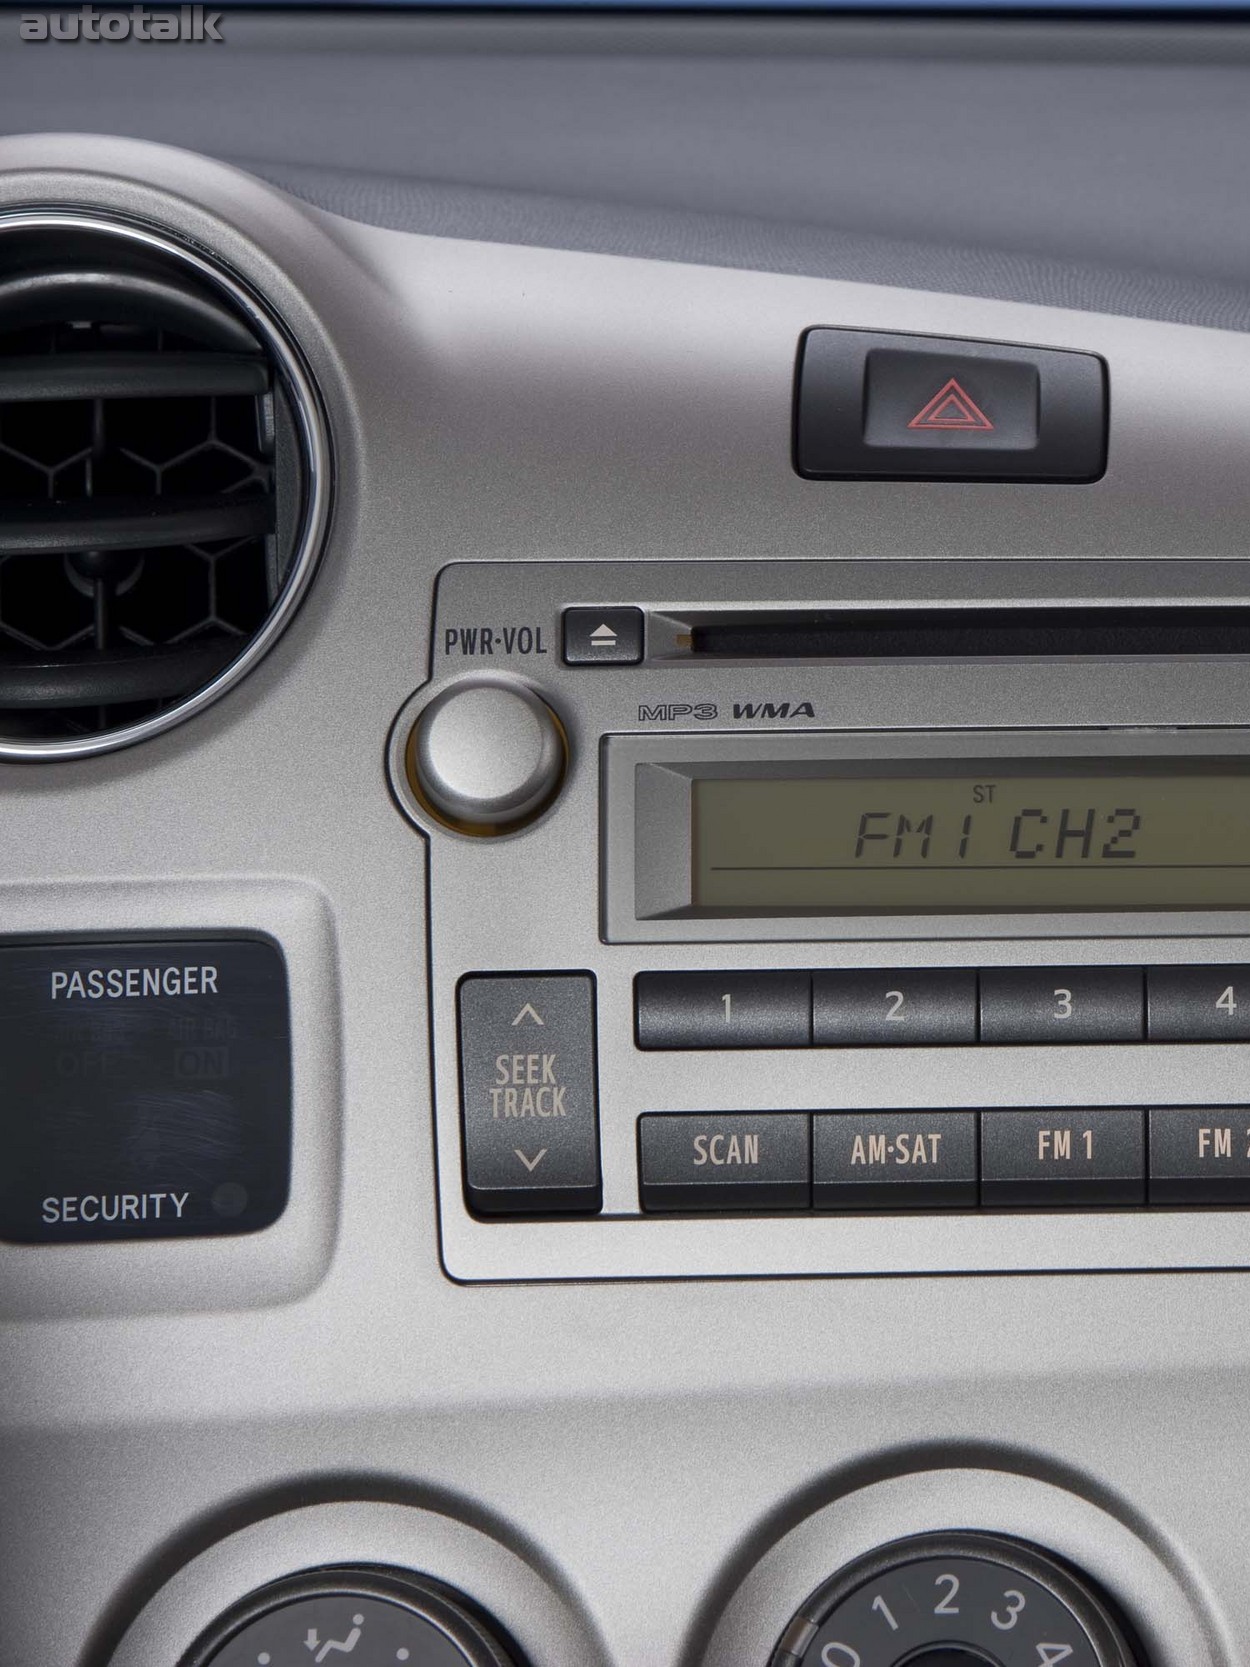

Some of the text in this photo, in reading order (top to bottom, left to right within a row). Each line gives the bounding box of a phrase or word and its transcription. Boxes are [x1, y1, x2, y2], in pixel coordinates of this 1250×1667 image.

[638, 702, 815, 721] MP3 WMA
[973, 785, 996, 803] ST
[51, 966, 218, 999] PASSENGER
[720, 993, 734, 1023] 1
[884, 991, 906, 1021] 2
[1053, 988, 1072, 1019] 3
[1215, 986, 1237, 1016] 4
[495, 1054, 556, 1085] SEEK
[490, 1087, 566, 1118] TRACK
[692, 1134, 759, 1165] SCAN
[1037, 1129, 1092, 1160] FM 1
[1198, 1128, 1232, 1158] FM
[41, 1192, 190, 1223] SECURITY
[933, 1573, 960, 1615] 2
[871, 1594, 899, 1631] 1
[991, 1589, 1026, 1631] 3
